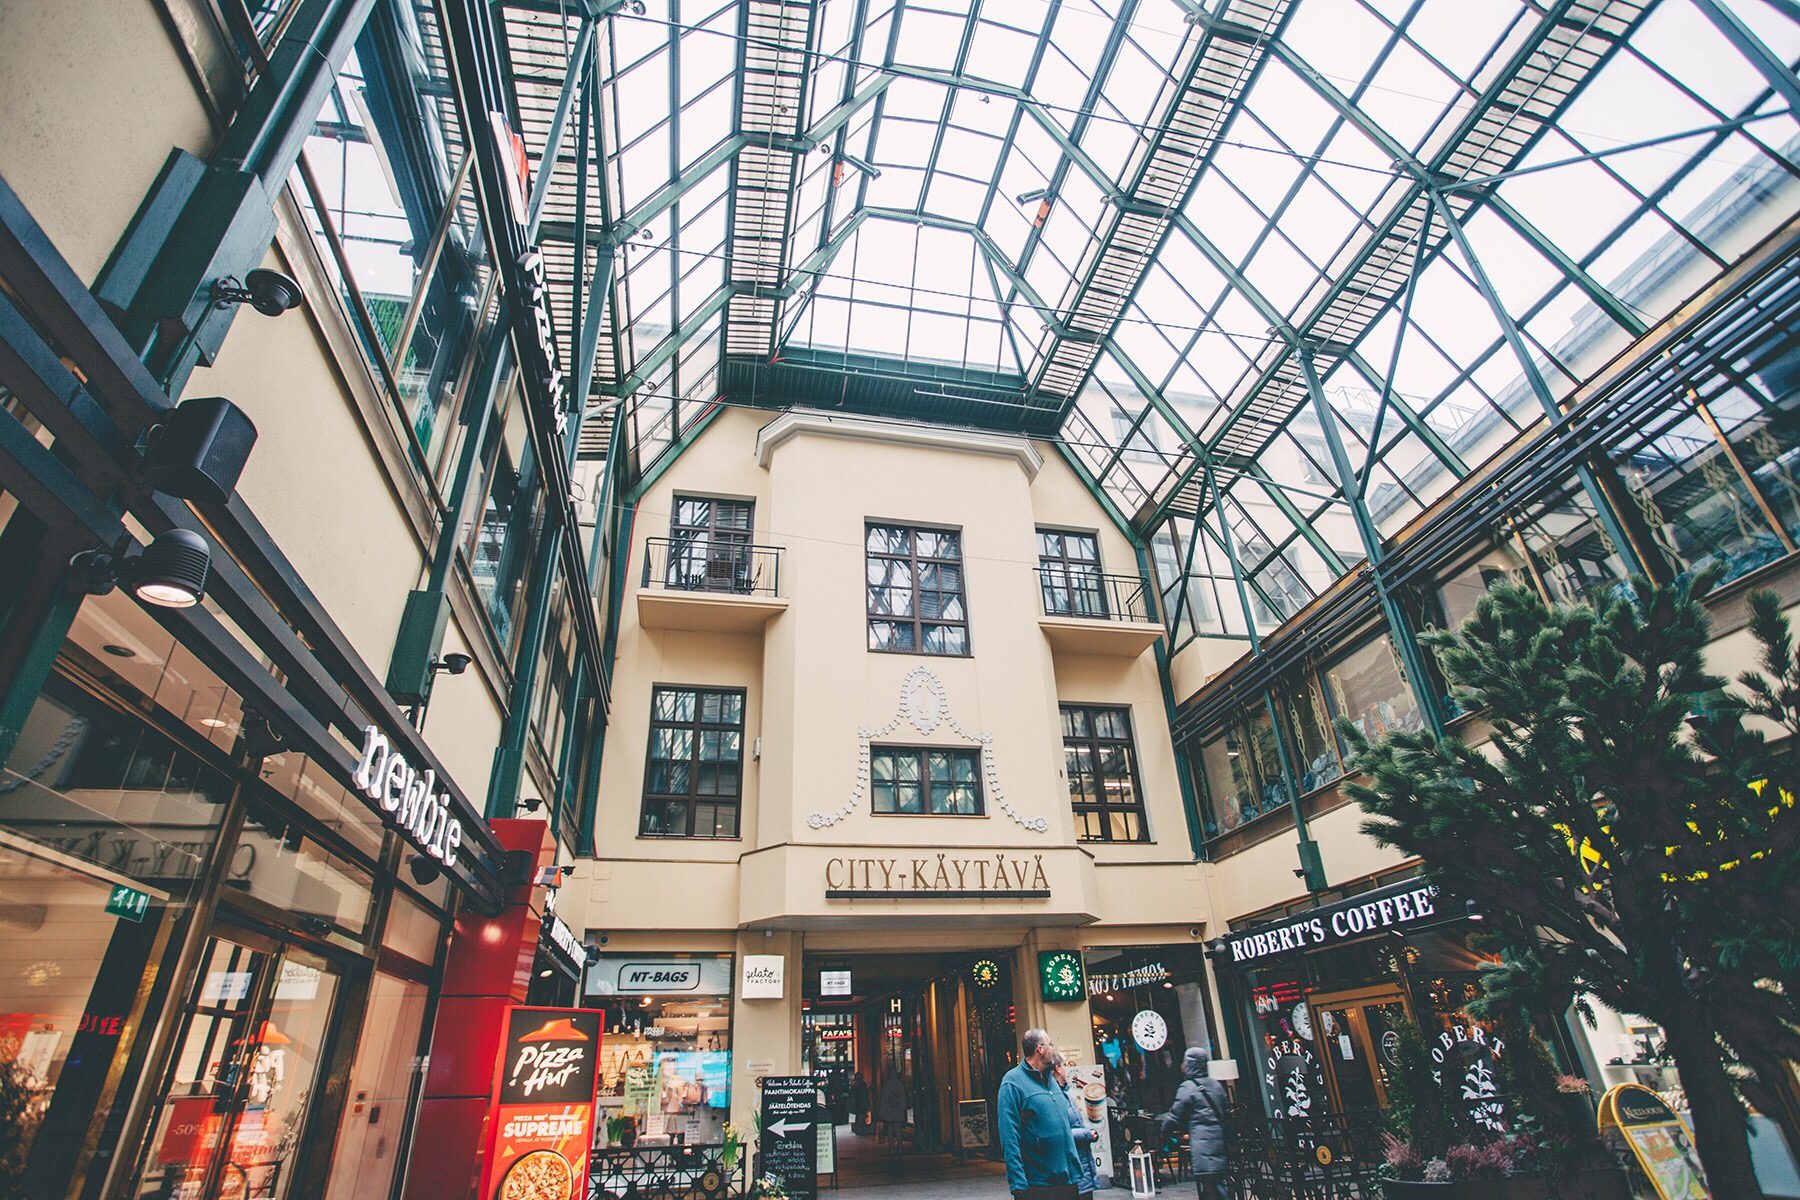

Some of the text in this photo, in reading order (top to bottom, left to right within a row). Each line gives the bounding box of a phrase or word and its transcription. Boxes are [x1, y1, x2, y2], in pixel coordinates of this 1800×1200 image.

[352, 725, 461, 867] newbie
[825, 853, 1050, 890] CITY-KÄYTÄVÄ
[1230, 918, 1325, 962] ROBERT'S
[1331, 887, 1435, 938] COFFEE
[1045, 953, 1080, 973] ROBERT'S
[629, 971, 690, 983] NT-BAGS
[746, 967, 774, 983] gelato
[1048, 979, 1081, 996] COFFEE
[822, 1029, 853, 1037] FAFA'S
[508, 1041, 585, 1087] Pizza
[172, 1124, 206, 1136] -50%
